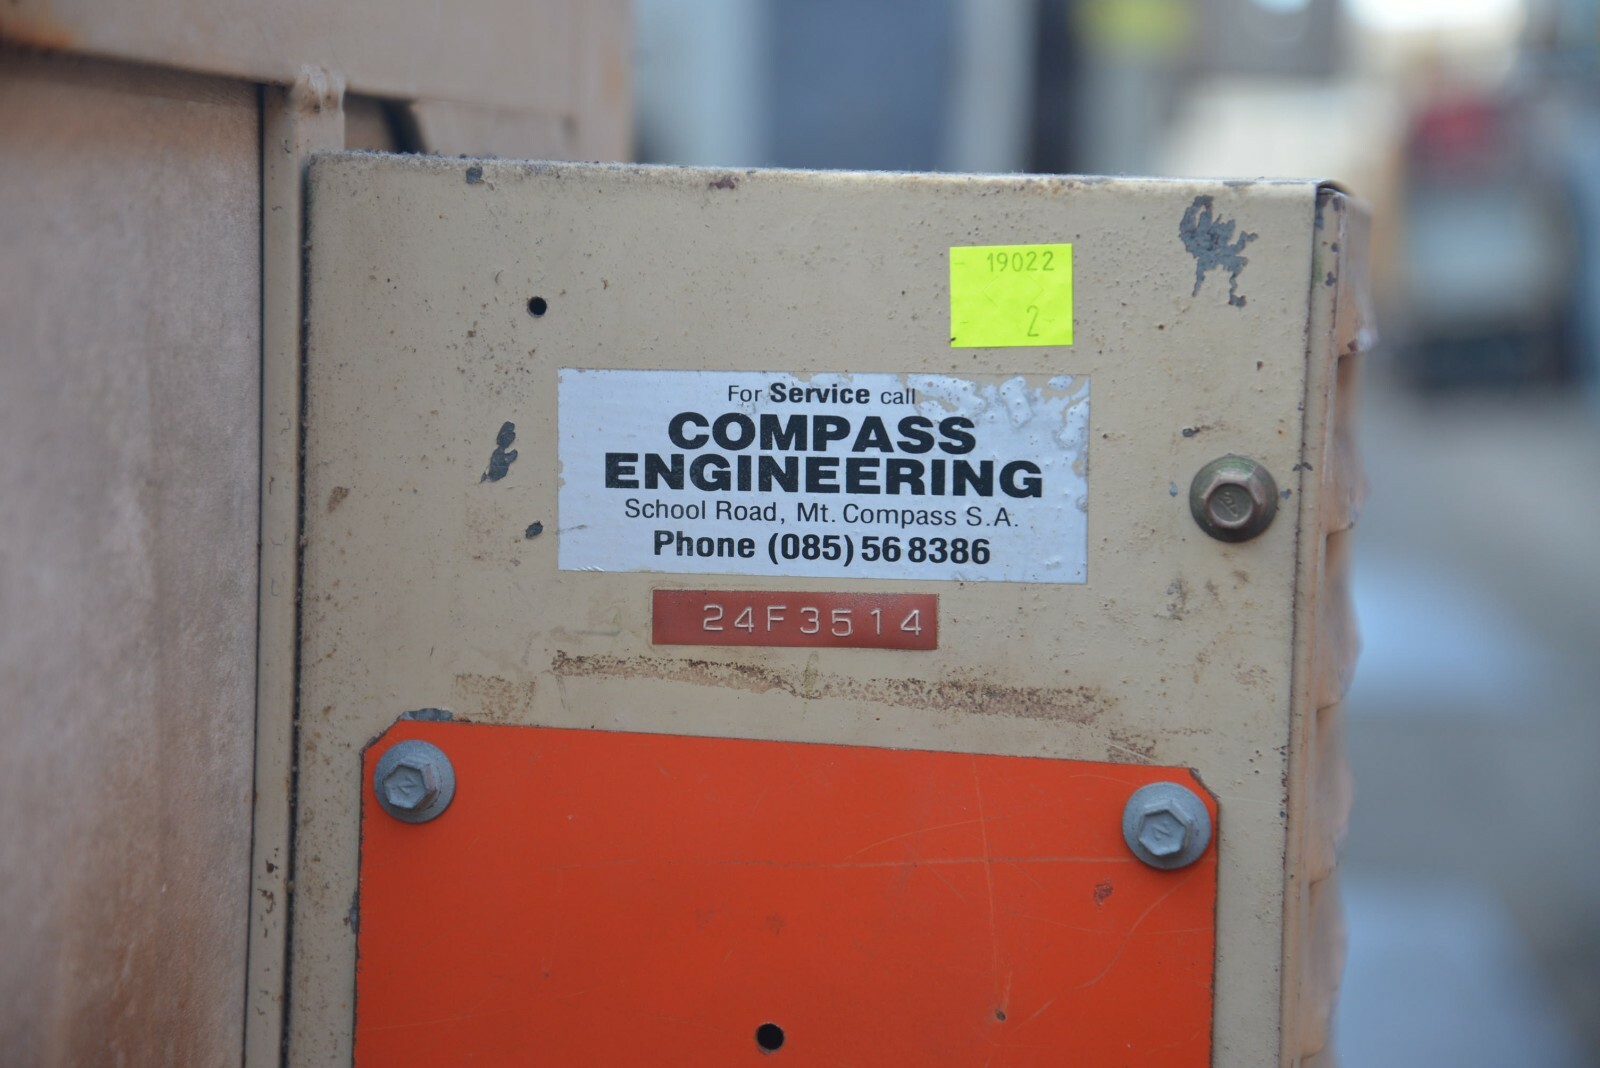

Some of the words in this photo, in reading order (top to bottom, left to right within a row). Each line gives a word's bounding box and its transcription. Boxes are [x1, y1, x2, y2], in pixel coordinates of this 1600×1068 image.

[987, 251, 1055, 272] 19022
[1026, 305, 1039, 337] 2
[728, 384, 763, 403] For
[770, 382, 870, 405] Service
[880, 388, 917, 405] call
[668, 411, 976, 455] COMPASS
[604, 452, 1043, 498] ENGINEERING
[624, 498, 706, 521] School
[715, 501, 785, 525] Road,
[797, 502, 836, 524] Mt.
[843, 503, 957, 529] Compass
[966, 507, 1020, 528] S.A.
[653, 530, 755, 559] Phone
[702, 603, 923, 638] 24F3514
